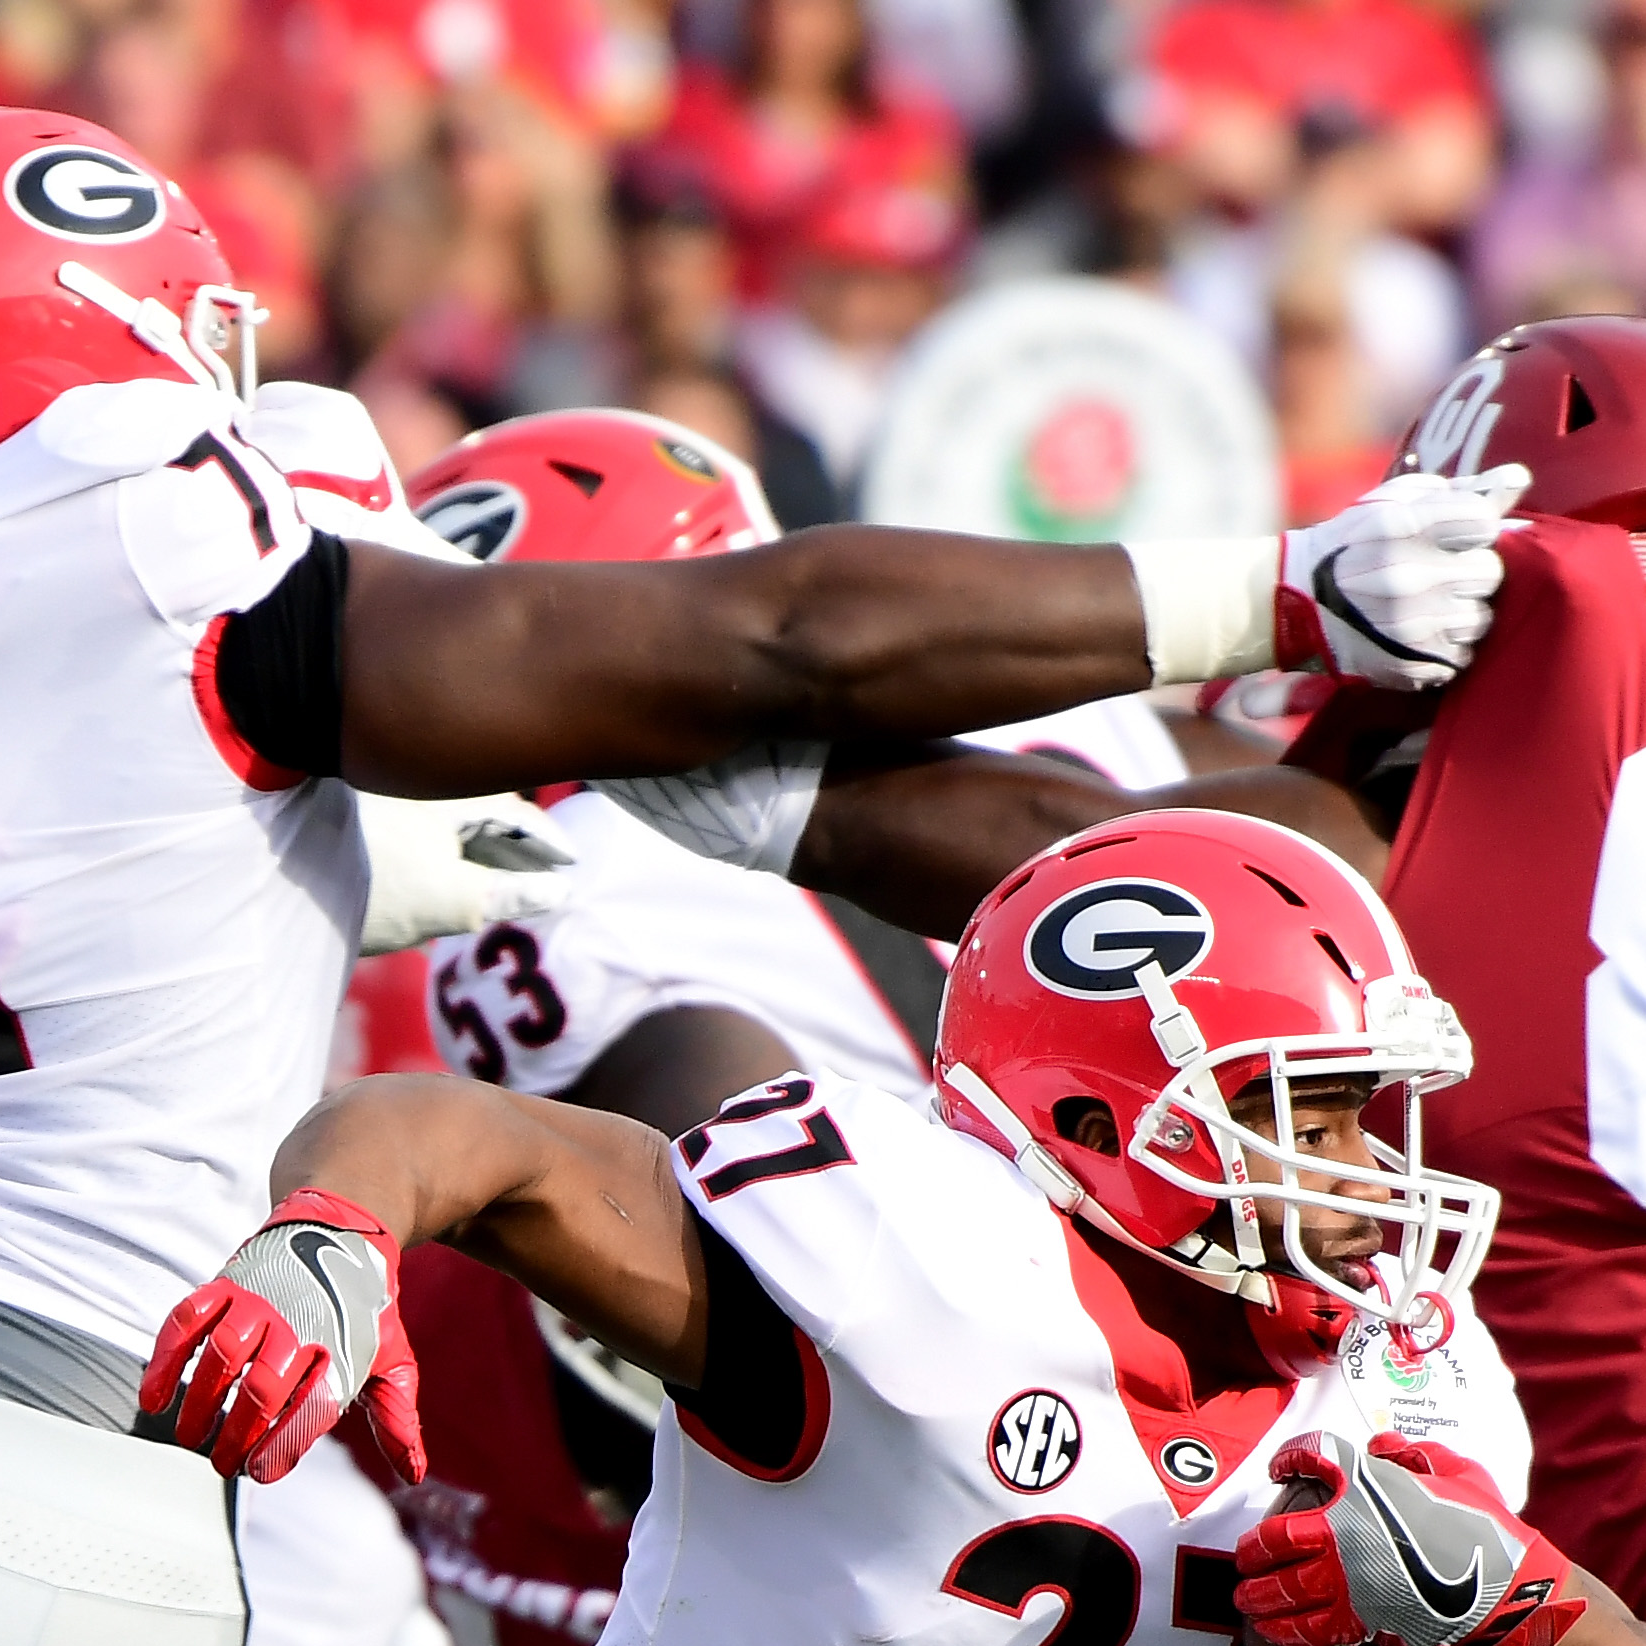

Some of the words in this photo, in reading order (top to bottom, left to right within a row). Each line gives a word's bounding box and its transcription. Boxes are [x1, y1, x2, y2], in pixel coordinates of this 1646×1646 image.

[14, 149, 159, 236] G
[1030, 883, 1207, 992] G
[434, 921, 567, 1085] 53
[677, 1078, 858, 1204] 27
[1231, 1159, 1257, 1223] DAGS
[1348, 1337, 1370, 1380] ROSE
[995, 1394, 1078, 1487] SEC
[1163, 1440, 1215, 1484] G
[1393, 1411, 1459, 1428] Northwestern
